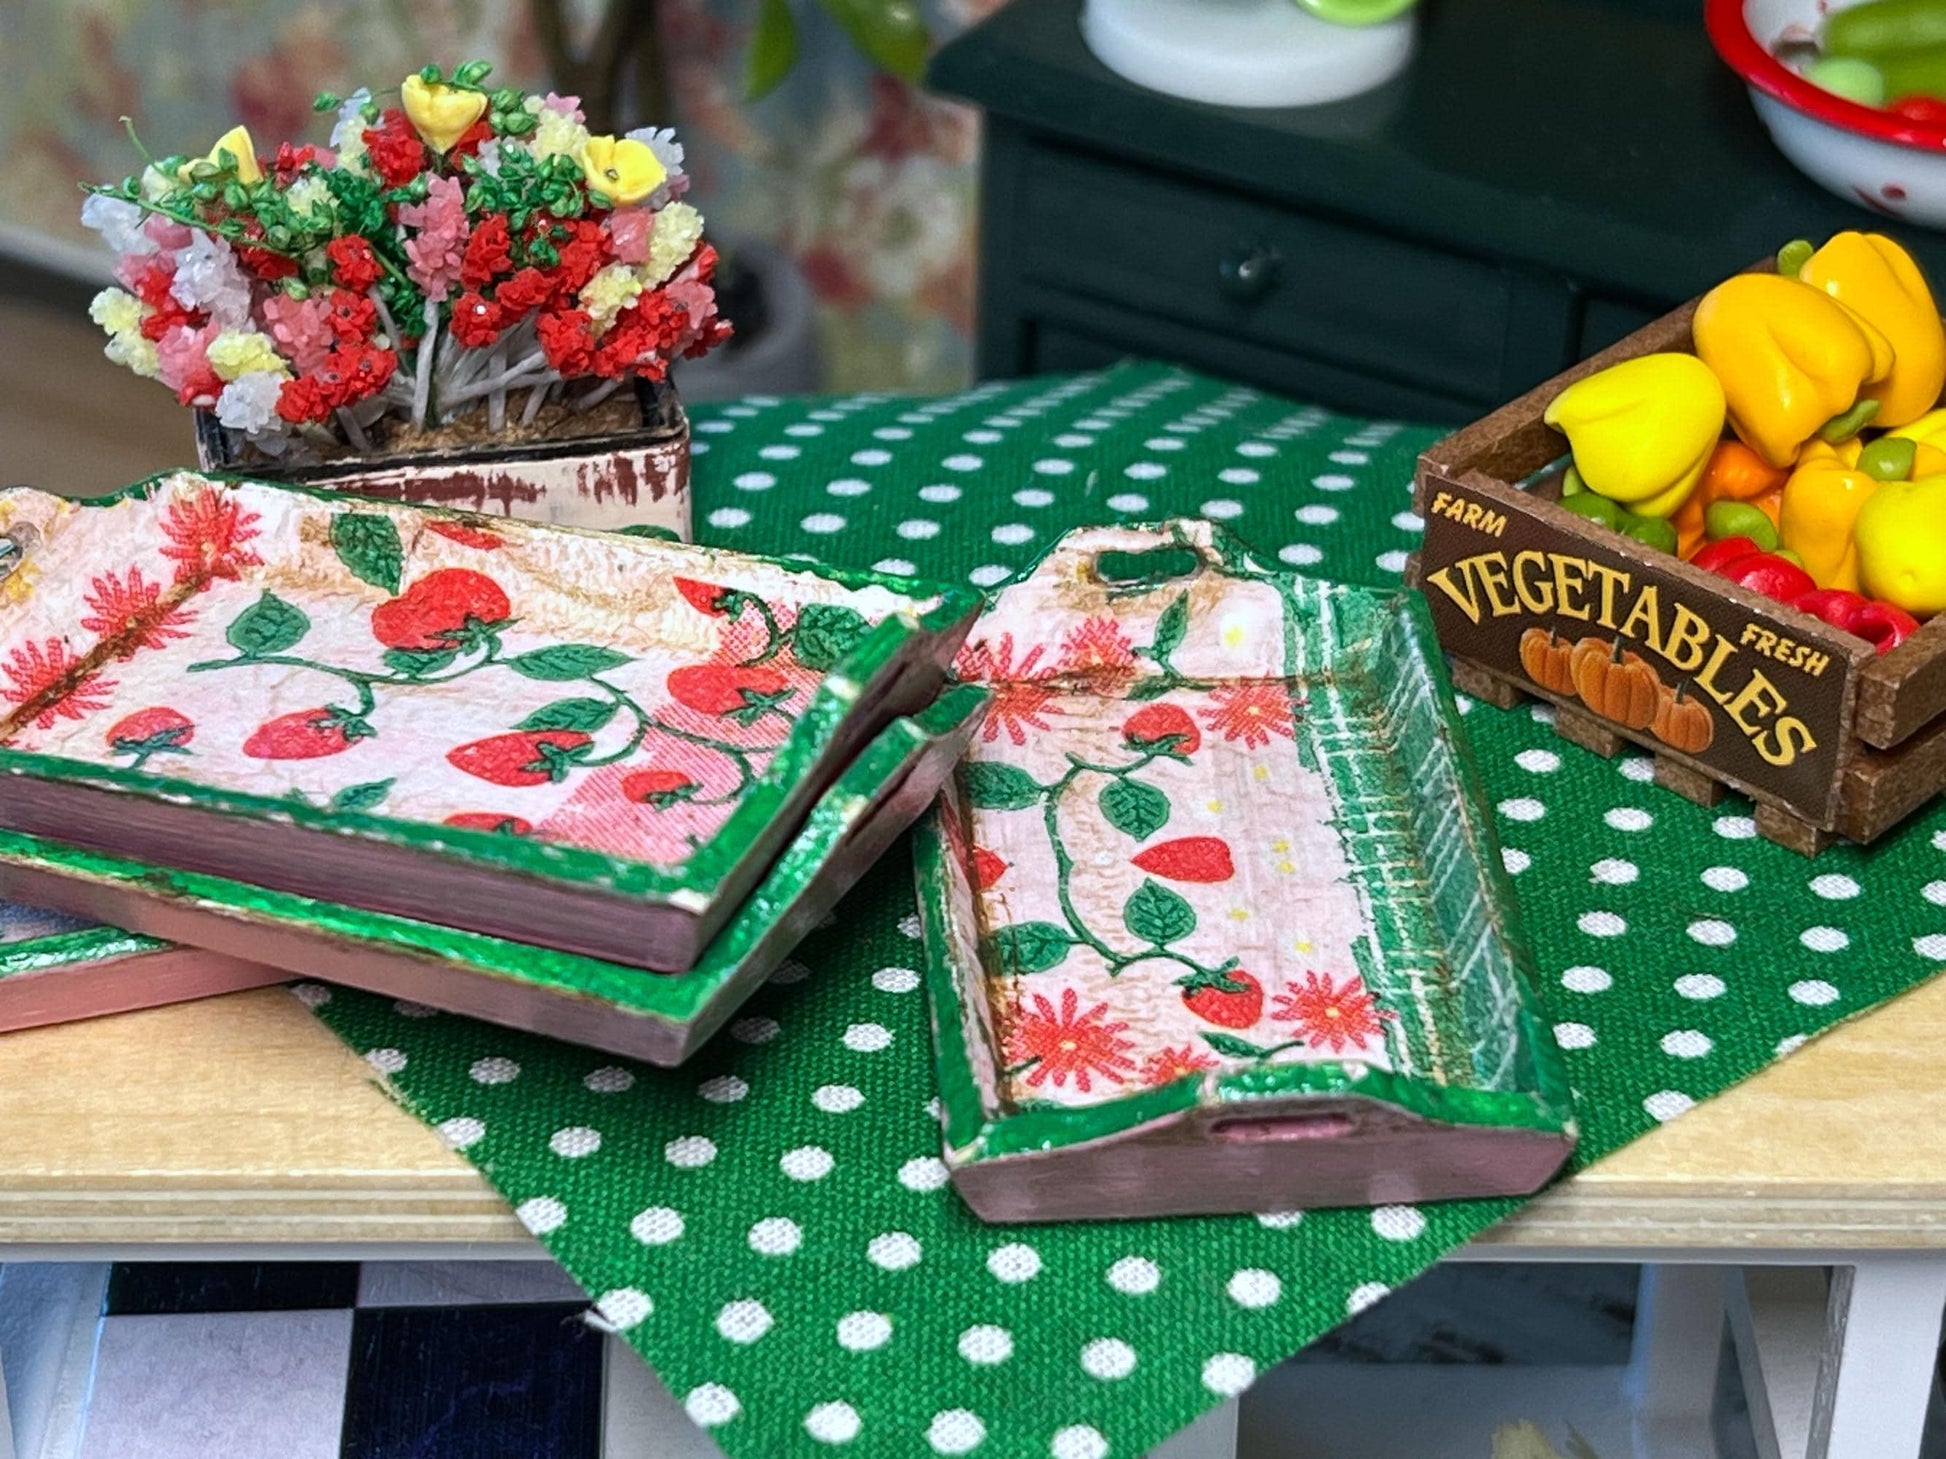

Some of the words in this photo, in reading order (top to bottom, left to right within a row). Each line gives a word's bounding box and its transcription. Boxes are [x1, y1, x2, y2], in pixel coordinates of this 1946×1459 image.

[1431, 492, 1508, 538] FARM
[1428, 550, 1817, 767] VEGETABLES
[1740, 623, 1831, 677] FRESH
